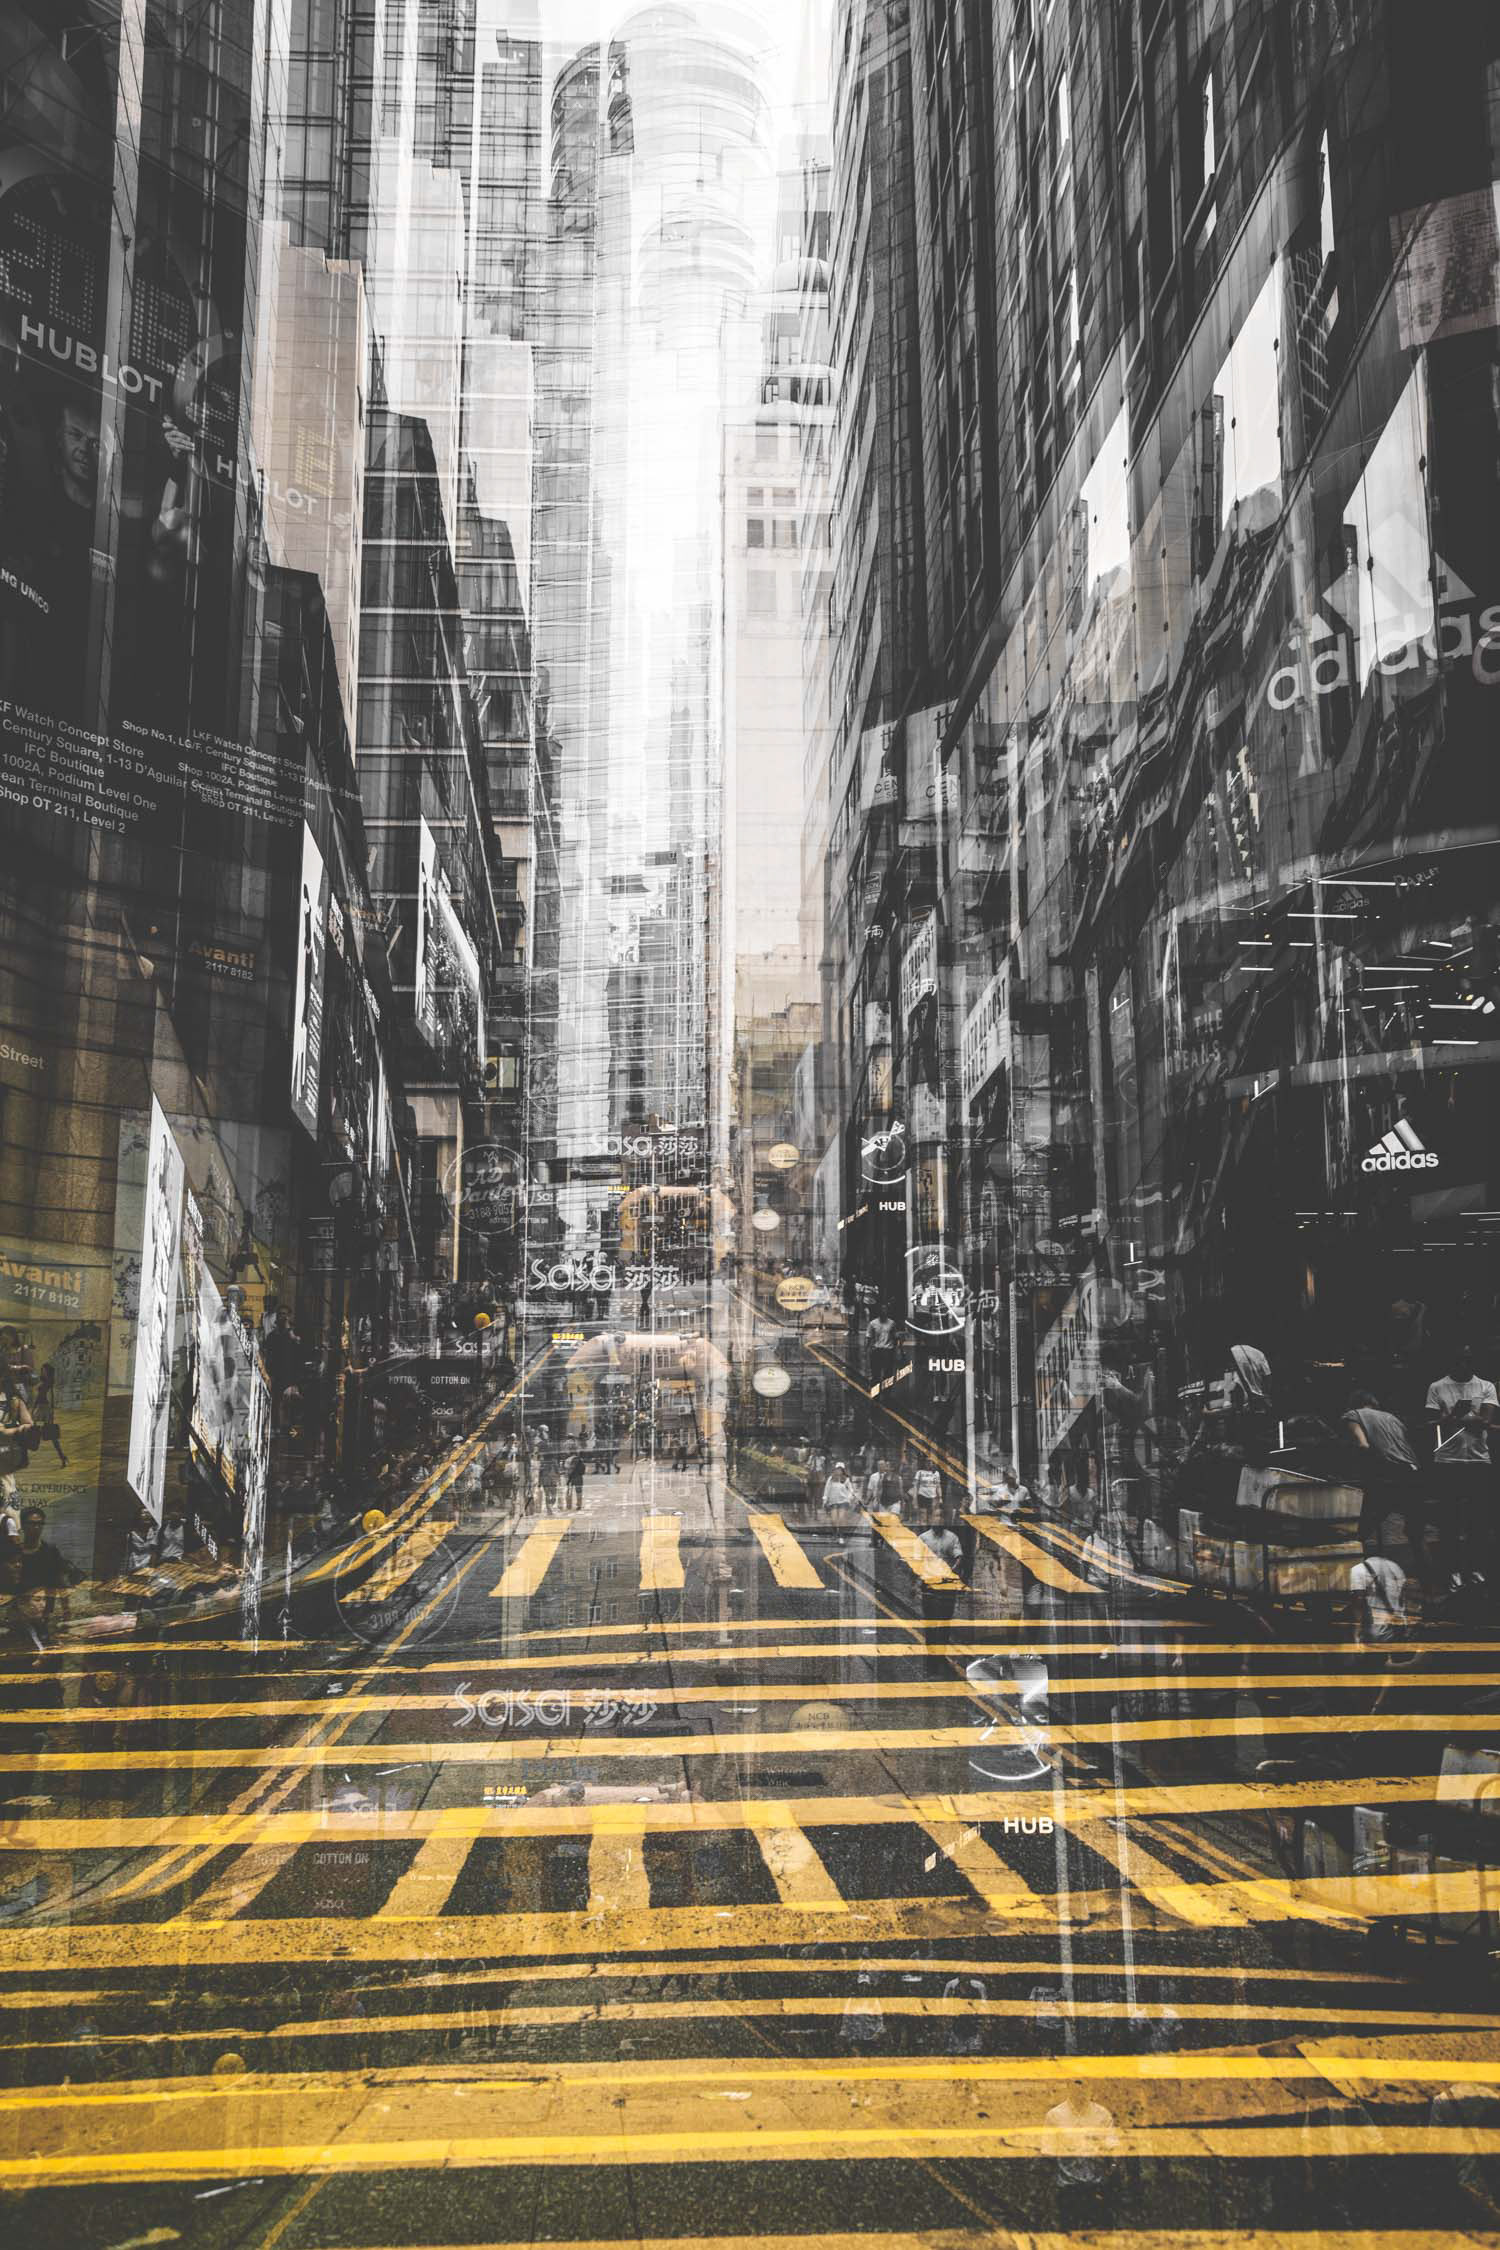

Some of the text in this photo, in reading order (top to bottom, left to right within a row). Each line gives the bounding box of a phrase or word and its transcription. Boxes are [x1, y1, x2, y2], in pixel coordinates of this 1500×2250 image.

[21, 314, 162, 402] HUBLOT
[20, 581, 49, 614] UNICO
[15, 705, 54, 728] Watch
[58, 720, 110, 747] Concept
[113, 738, 145, 759] Store
[122, 719, 149, 737] Shop
[205, 745, 241, 765] Century
[193, 728, 212, 741] LKF
[214, 735, 243, 753] Watch
[244, 745, 282, 766] Concept
[2, 719, 53, 746] Century
[56, 737, 103, 763] Square,
[106, 754, 133, 771] 1-13
[136, 762, 188, 789] D'Aguilar
[25, 742, 105, 778] IFC Boutique
[48, 767, 96, 792] Podium
[99, 783, 130, 802] Level
[133, 795, 158, 812] One
[178, 761, 203, 777] Shop
[238, 779, 272, 797] Podium
[221, 762, 279, 787] IFC Boutique
[0, 771, 139, 822] ean Terminal Boutique
[32, 796, 51, 812] OT
[54, 803, 80, 822] 211,
[83, 811, 116, 831] Level
[118, 822, 126, 834] 2
[227, 801, 241, 812] OT
[288, 819, 295, 828] 2
[188, 941, 256, 969] Avanti
[204, 960, 254, 982] 2117 8182
[0, 1044, 45, 1070] Street
[1361, 1150, 1440, 1173] adidas
[879, 1201, 906, 1211] HUB
[530, 1258, 680, 1292] Sasa 莎莎
[14, 1283, 80, 1309] 2117 8182
[928, 1358, 966, 1372] HUB
[452, 1681, 658, 1728] Sasa 莎莎
[1003, 1815, 1055, 1835] HUB
